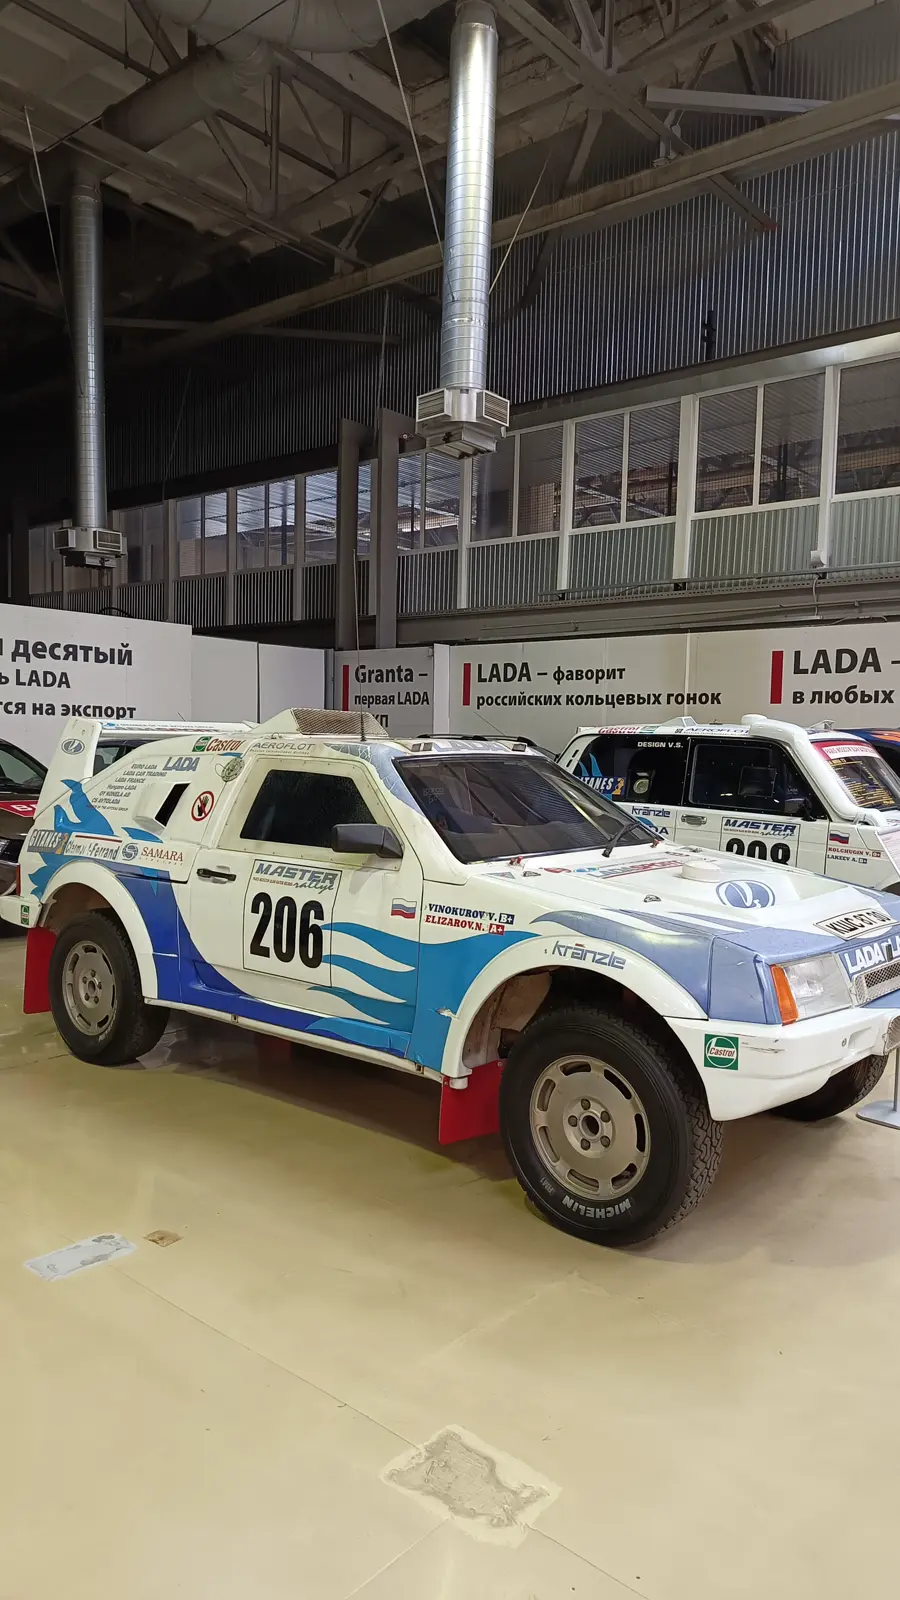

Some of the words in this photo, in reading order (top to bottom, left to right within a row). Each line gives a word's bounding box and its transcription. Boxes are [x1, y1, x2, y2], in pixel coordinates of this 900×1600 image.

[11, 639, 133, 666] десятый
[793, 647, 882, 675] LADA
[15, 668, 71, 688] LADA
[354, 664, 414, 683] Granta
[477, 661, 532, 683] LADA
[552, 665, 626, 685] фаворит
[354, 694, 395, 708] первая
[397, 691, 430, 705] LADA
[476, 691, 562, 710] российских
[565, 693, 662, 709] кольцевых
[666, 692, 722, 705] гонок
[792, 690, 805, 704] в
[809, 684, 895, 704] любых
[32, 702, 56, 716] на
[60, 704, 137, 720] экспорт
[205, 738, 247, 752] Castrol
[253, 742, 316, 751] AEROFLOT
[163, 756, 200, 772] LADA
[723, 818, 797, 833] MASTER
[141, 847, 183, 862] SAMARA
[256, 863, 338, 884] MASTER
[428, 903, 486, 919] VINOKUROV
[250, 892, 324, 968] 206
[710, 1047, 735, 1057] Castrol
[562, 1195, 632, 1218] MICHELIN
